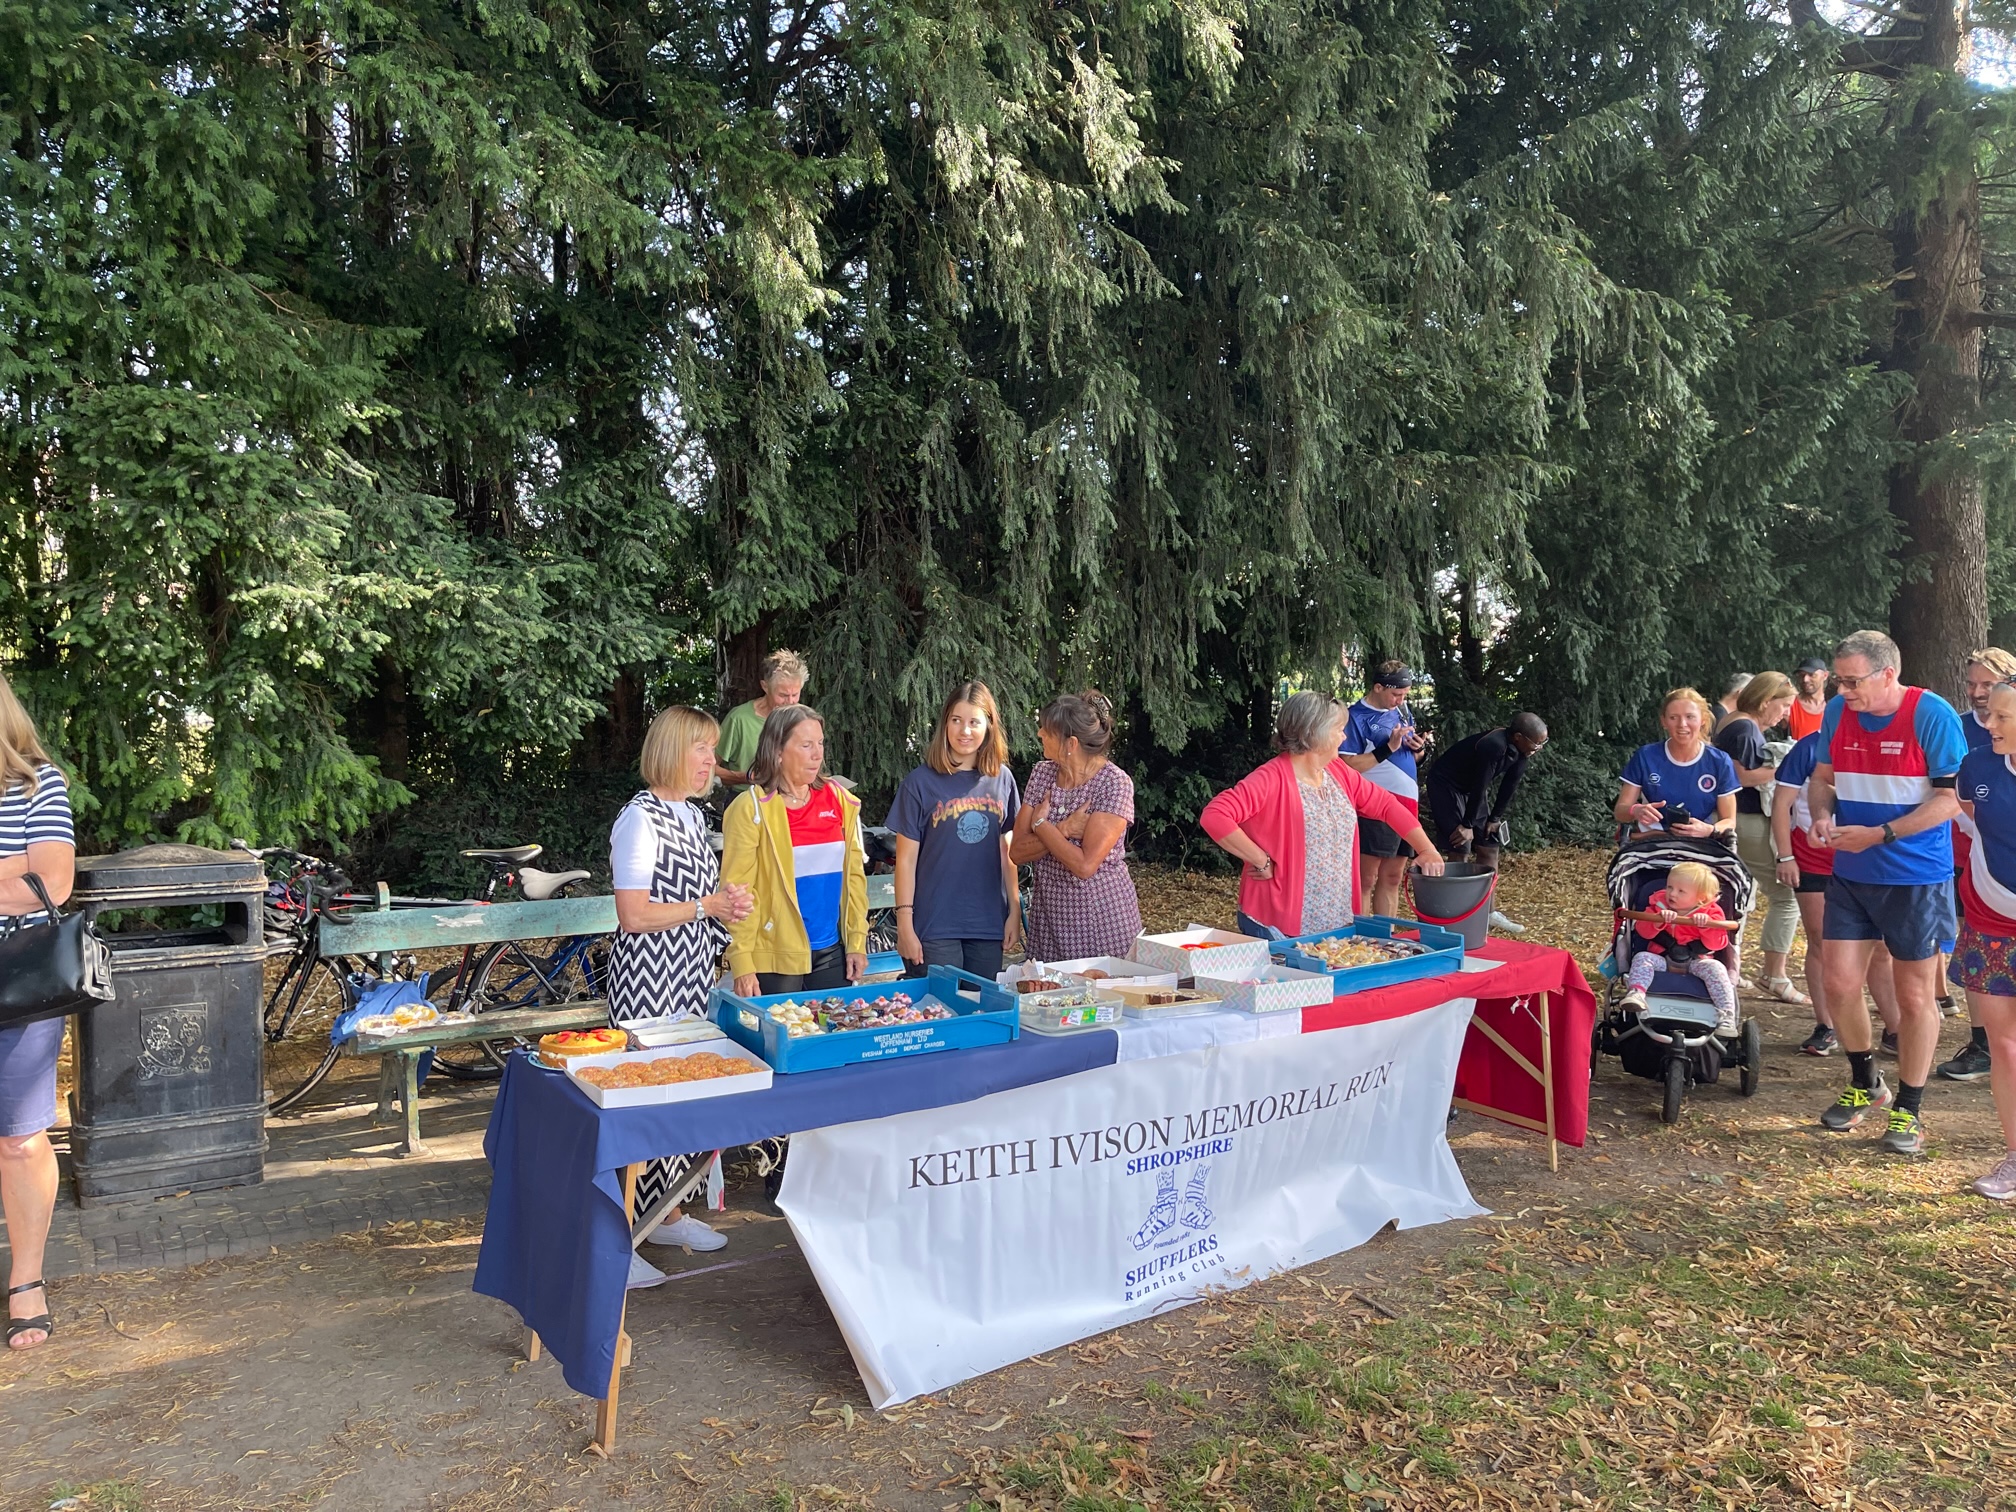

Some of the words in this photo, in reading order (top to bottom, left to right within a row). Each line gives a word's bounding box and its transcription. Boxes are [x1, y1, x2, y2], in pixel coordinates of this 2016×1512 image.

[862, 1050, 883, 1058] EVESHAM
[903, 1043, 922, 1052] DEPOSIT
[924, 1041, 945, 1049] CHARGED
[873, 1032, 903, 1043] WESTLAND
[904, 1028, 934, 1038] NURSERIES
[880, 1037, 912, 1049] (OFFENHAM)
[908, 1139, 1037, 1189] KEITH
[1049, 1116, 1175, 1169] IVISON
[1182, 1082, 1339, 1144] MEMORIAL
[1343, 1061, 1394, 1102] RUN
[1126, 1137, 1234, 1176] SHROPSHIRE
[1153, 1234, 1180, 1251] Founded
[1125, 1233, 1218, 1287] SHUFFLERS
[1124, 1270, 1186, 1302] Running
[1192, 1253, 1225, 1273] Club
